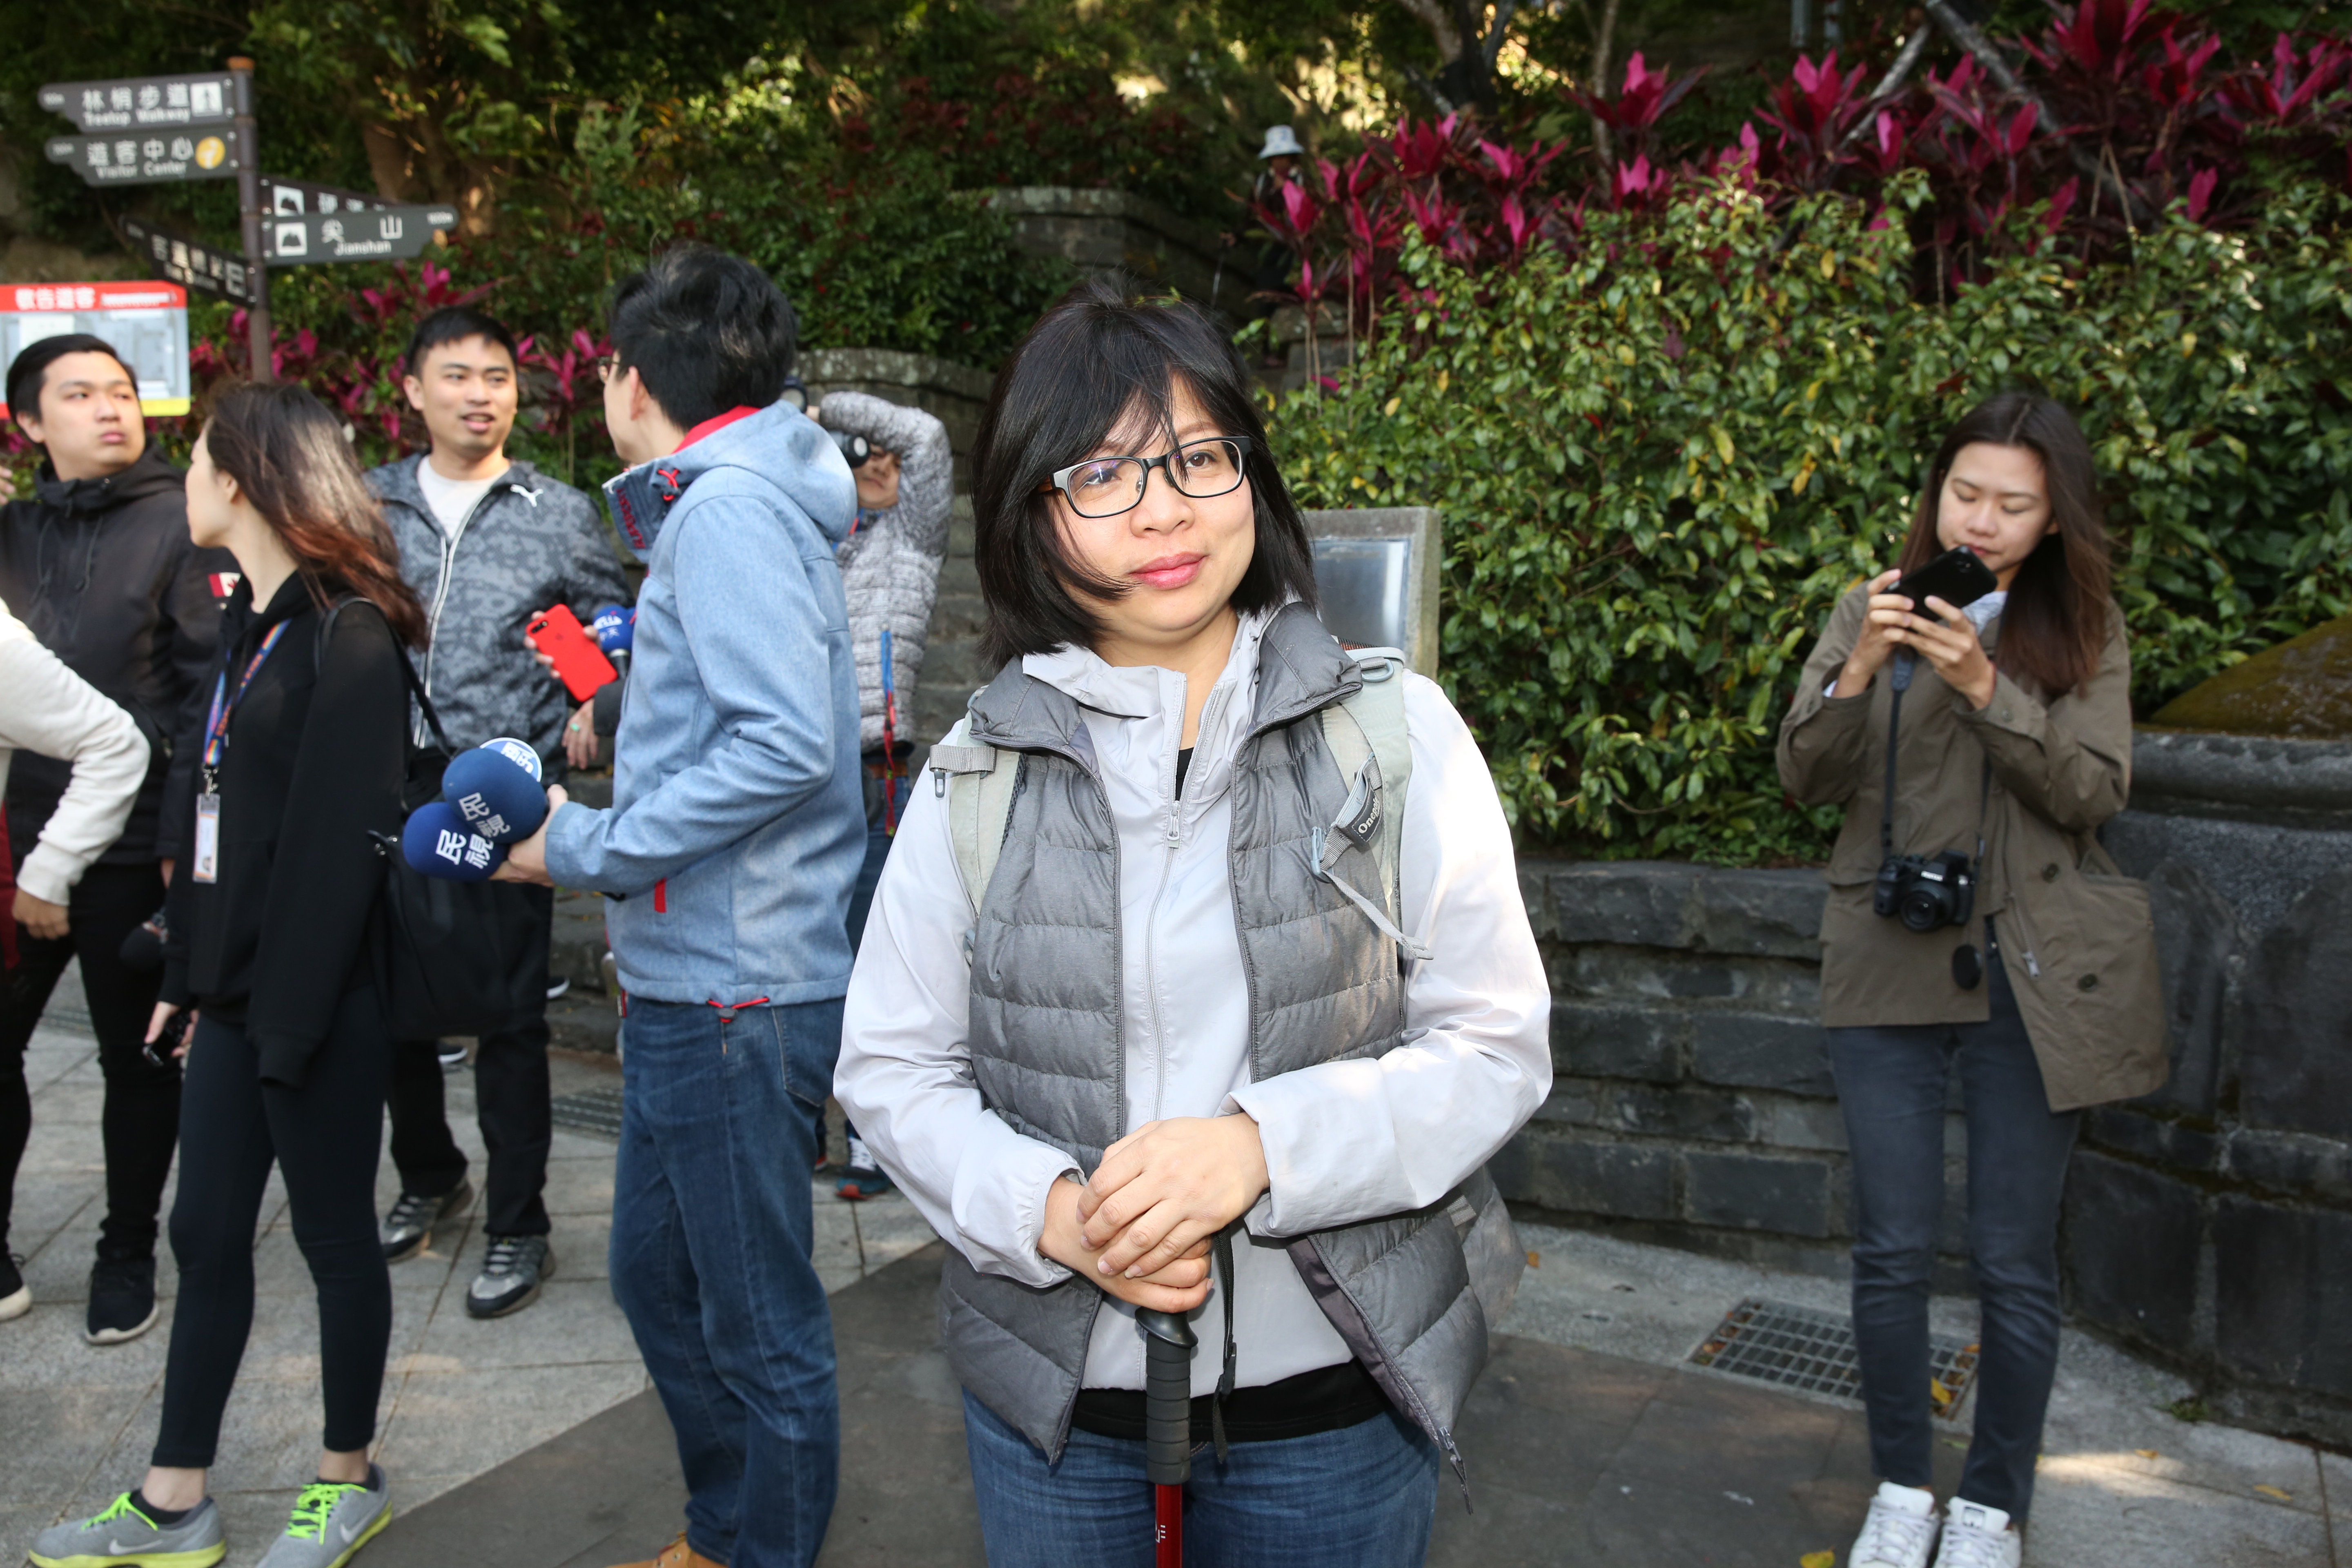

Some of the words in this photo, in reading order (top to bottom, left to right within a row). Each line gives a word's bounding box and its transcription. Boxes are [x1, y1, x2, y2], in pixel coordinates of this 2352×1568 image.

[136, 107, 191, 122] Walkway
[87, 136, 194, 166] 遊客中心
[96, 165, 138, 179] Visitor
[143, 160, 186, 178] Center
[322, 215, 403, 243] 尖山
[334, 239, 392, 256] Jianshan
[15, 287, 95, 310] 敬告遊客
[458, 792, 511, 838] 民視
[436, 829, 494, 869] 民視
